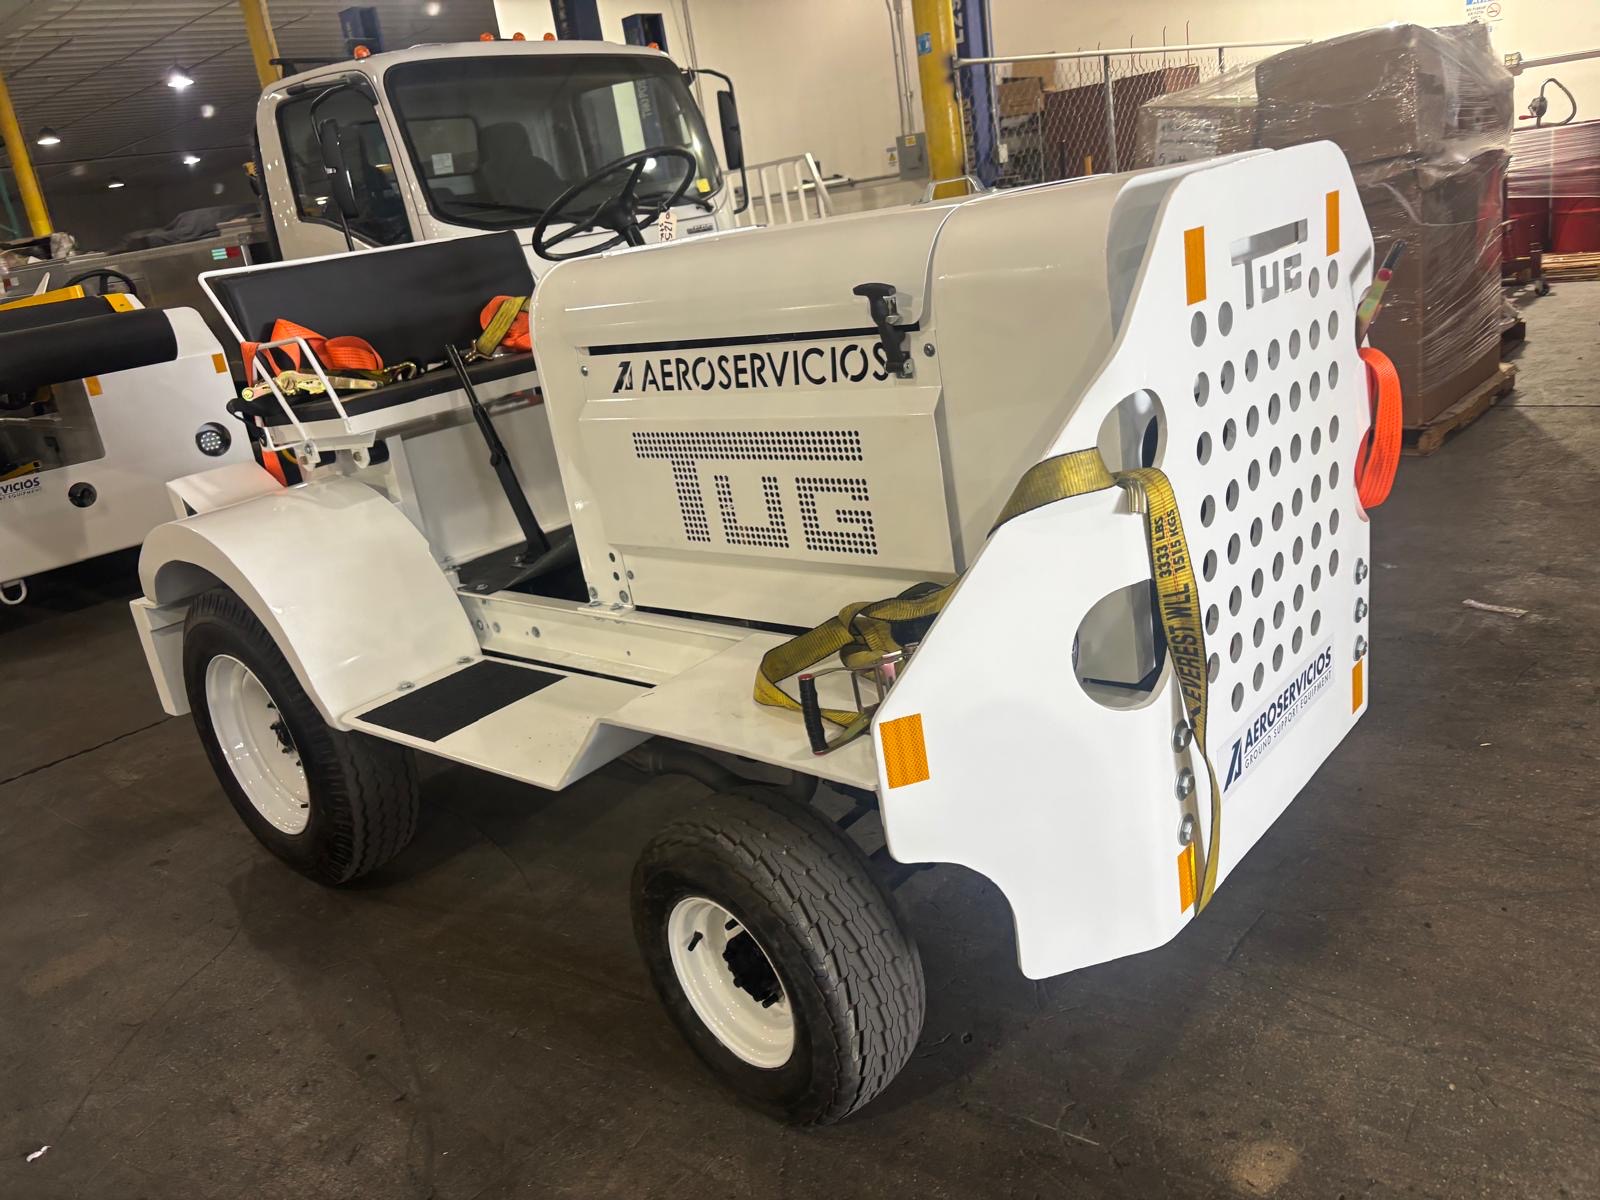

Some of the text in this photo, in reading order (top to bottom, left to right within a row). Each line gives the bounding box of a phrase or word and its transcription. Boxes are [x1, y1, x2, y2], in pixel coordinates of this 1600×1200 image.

[1230, 218, 1308, 310] TUG
[641, 342, 889, 392] AEROSERVICIOS
[632, 430, 878, 555] TUG
[1154, 516, 1172, 578] 3333 LBS
[1167, 509, 1186, 573] 1515 KGS
[1162, 583, 1202, 703] EVEREST WLL
[1244, 645, 1332, 753] AEROSERVICIOS
[1244, 670, 1332, 769] GROUND SUPPORT EQUIPMENT
